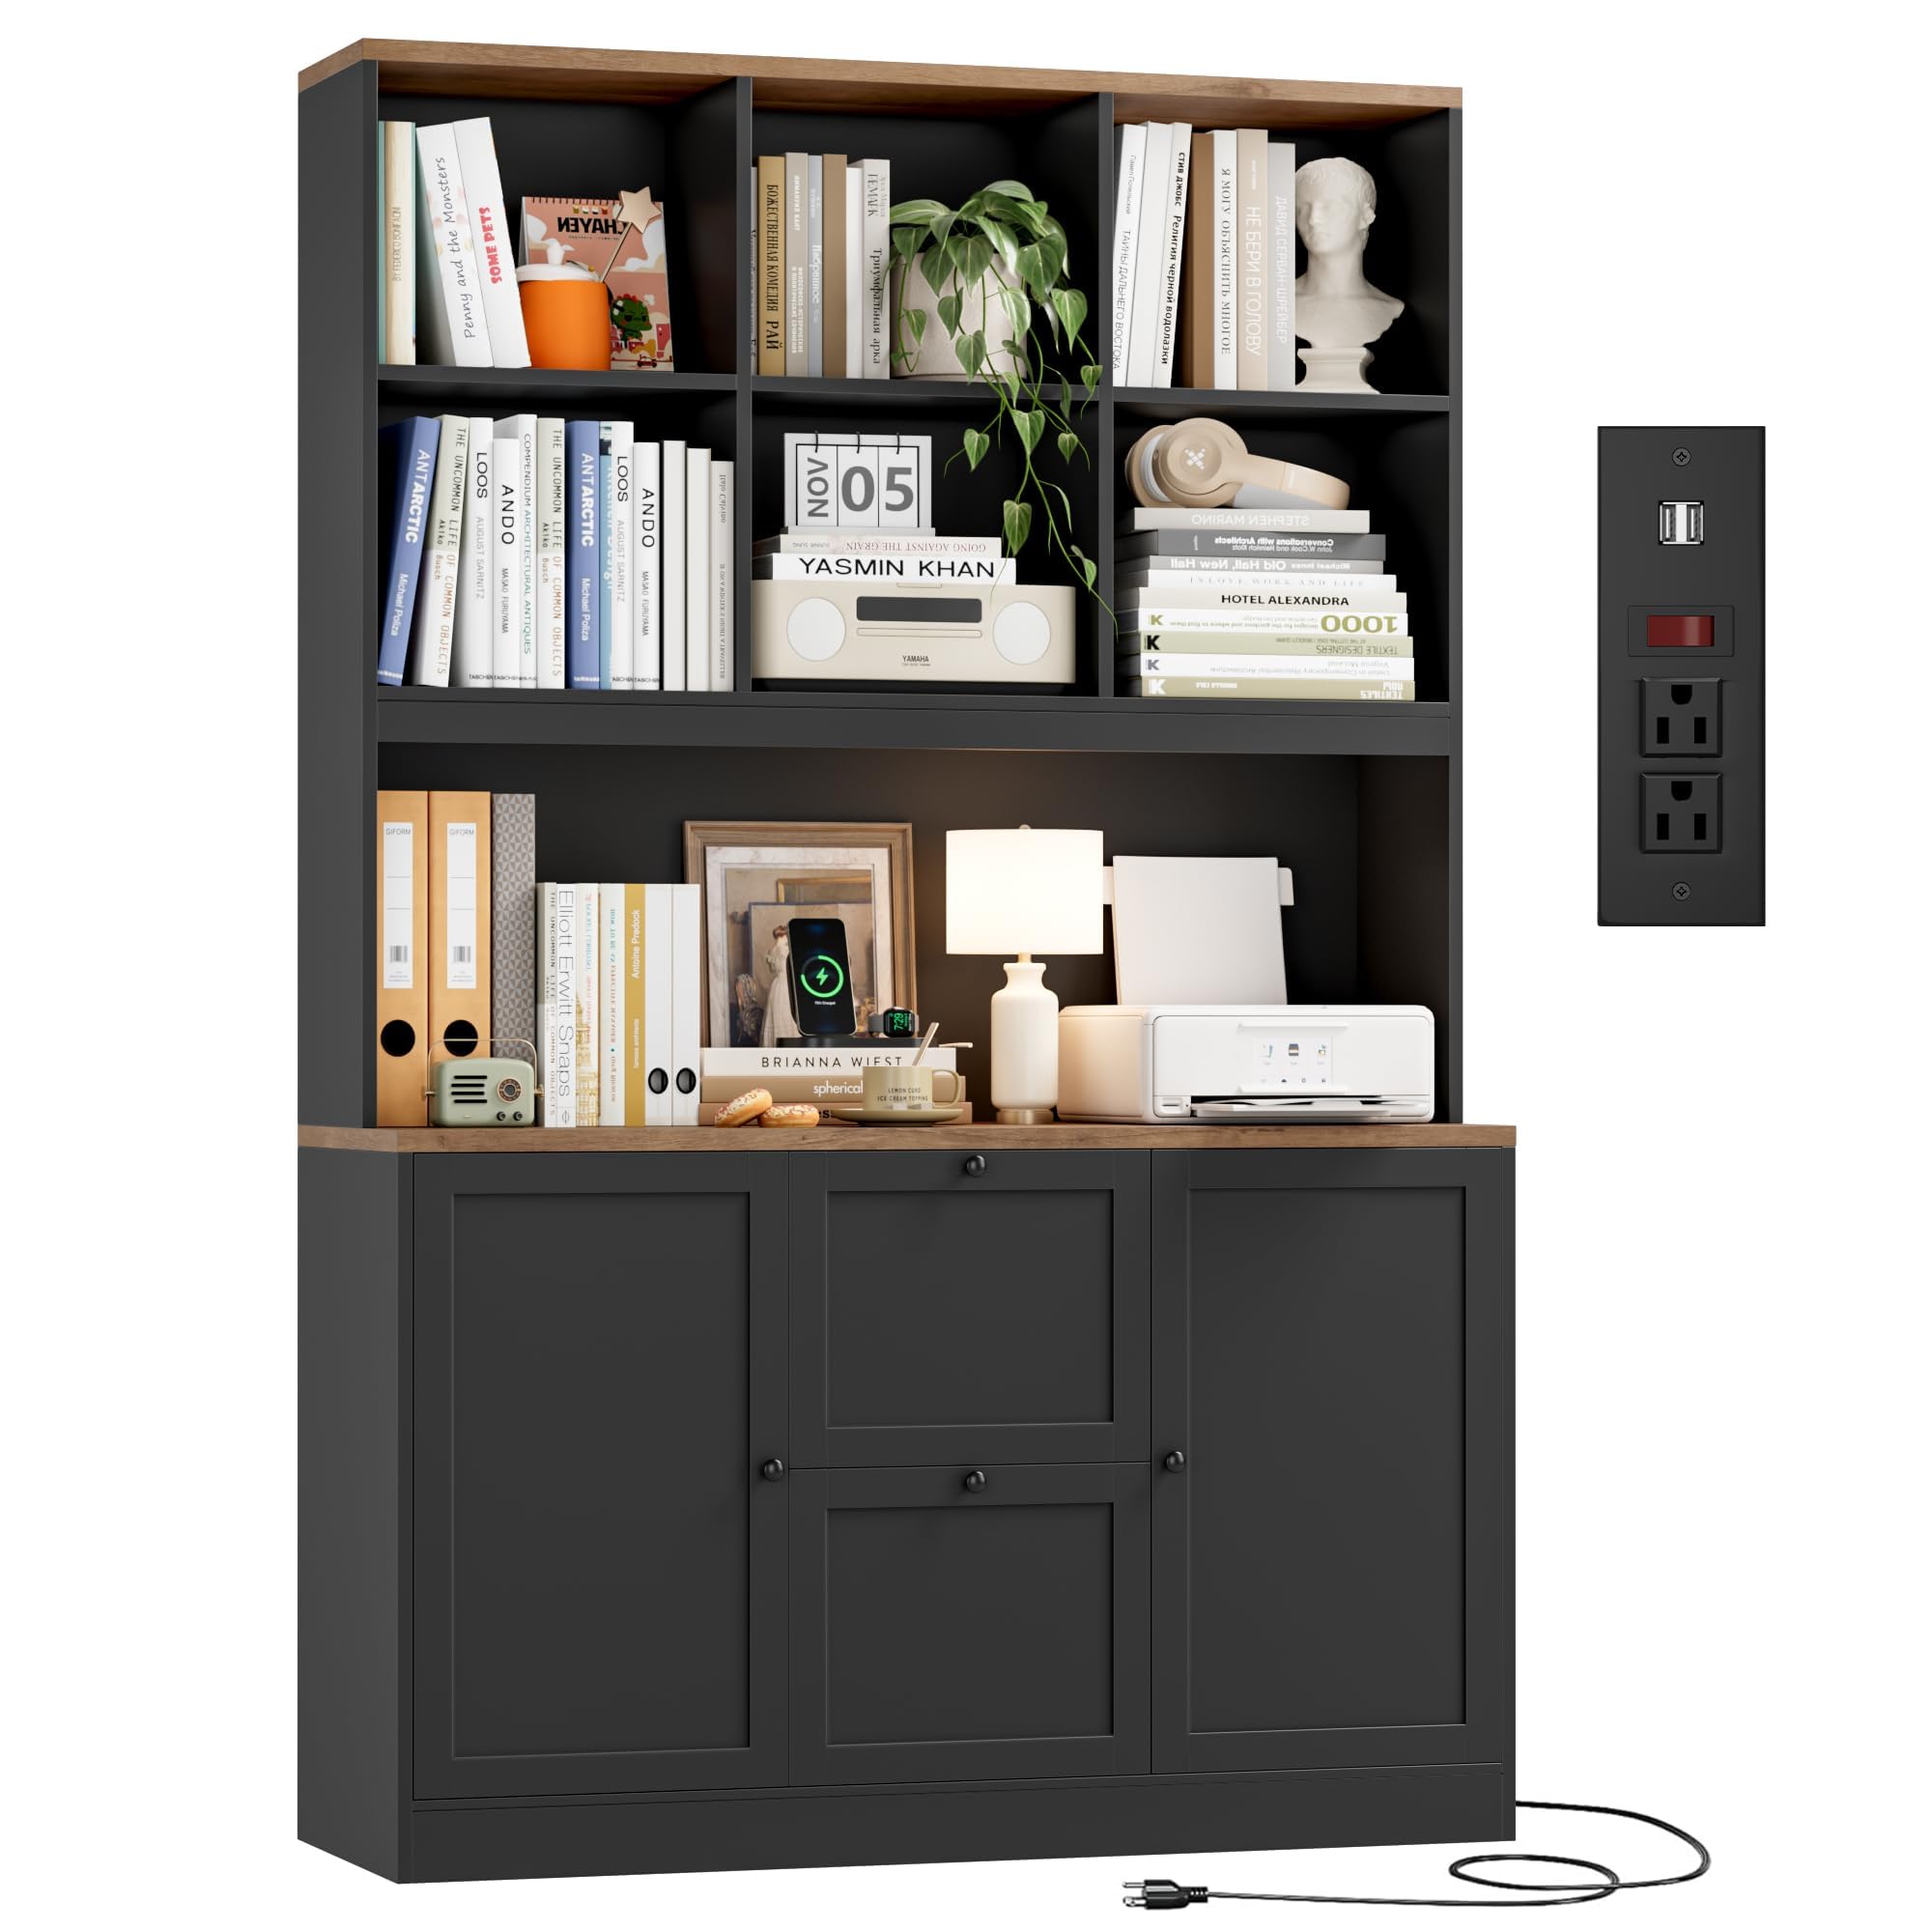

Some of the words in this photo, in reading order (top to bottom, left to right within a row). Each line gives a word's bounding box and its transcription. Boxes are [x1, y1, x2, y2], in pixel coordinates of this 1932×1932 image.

[435, 156, 456, 223] Monsters
[1221, 181, 1231, 215] МОГУ
[478, 207, 496, 242] PETS
[766, 185, 779, 262] БОЖЕСТВЕННАЯ
[1246, 207, 1260, 225] НЕ
[1275, 196, 1289, 236] ДАВИД
[447, 230, 461, 253] the
[1170, 215, 1182, 260] Религия
[1246, 232, 1261, 272] БЕРИ
[456, 259, 467, 287] and
[485, 244, 502, 284] SOME
[1221, 220, 1231, 297] ОБЪЯСНИТЬ
[765, 265, 779, 311] КОМЕДИЯ
[869, 247, 883, 333] Триумфальная
[1116, 266, 1128, 321] ДАЛЬНЕГО
[1166, 265, 1176, 303] черной
[1246, 278, 1261, 287] В
[1276, 241, 1290, 344] СЕРВАН-ШРЕЙБЕР
[464, 293, 475, 339] Penny
[1221, 302, 1231, 355] МНОГОЕ
[1246, 293, 1261, 356] ГОЛОВУ
[765, 321, 782, 350] РАЙ
[869, 338, 881, 364] арка
[1112, 323, 1123, 369] ВОСТОКА
[1161, 306, 1173, 364] водолазки
[456, 428, 467, 448] THE
[553, 429, 562, 448] THE
[450, 456, 464, 512] UNCOMMON
[476, 452, 488, 498] LOOS
[553, 457, 562, 513] UNCOMMON
[617, 456, 629, 502] LOOS
[807, 457, 829, 518] NOV
[841, 466, 914, 512] 05
[405, 448, 431, 544] ANTARCTIC
[582, 452, 594, 547] ANTARCTIC
[437, 520, 446, 545] Akiko
[501, 484, 515, 545] ANDO
[641, 488, 655, 548] ANDO
[447, 520, 459, 547] LIFE
[553, 522, 562, 549] LIFE
[846, 542, 879, 551] GRAIN
[882, 542, 902, 551] THE
[905, 542, 949, 552] AGAINST
[953, 543, 986, 553] GOING
[435, 554, 443, 580] Busch
[446, 554, 456, 566] OF
[553, 555, 562, 568] OF
[799, 557, 904, 576] YASMIN
[920, 559, 994, 578] KHAN
[395, 573, 410, 608] Michael
[442, 576, 454, 618] COMMON
[553, 579, 562, 619] COMMON
[582, 578, 591, 612] Michael
[1221, 594, 1264, 605] HOTEL
[1267, 595, 1350, 606] ALEXANDRA
[523, 600, 531, 655] ANTIQUES
[1151, 614, 1163, 626] K
[1321, 614, 1398, 634] 1000
[438, 625, 450, 675] OBJECTS
[553, 627, 562, 676] OBJECTS
[1147, 635, 1160, 650] K
[1316, 644, 1363, 654] DESIGNERS
[1366, 645, 1398, 655] TEXTILE
[1147, 659, 1160, 670] K
[558, 891, 574, 947] Elliott
[631, 945, 640, 980] Antoine
[558, 956, 574, 1016] Erwitt
[894, 1012, 904, 1031] 7:29
[556, 1025, 574, 1097] Snaps
[761, 1056, 841, 1067] BRIANNA
[851, 1056, 903, 1066] WIEST
[812, 1080, 864, 1096] spherical
